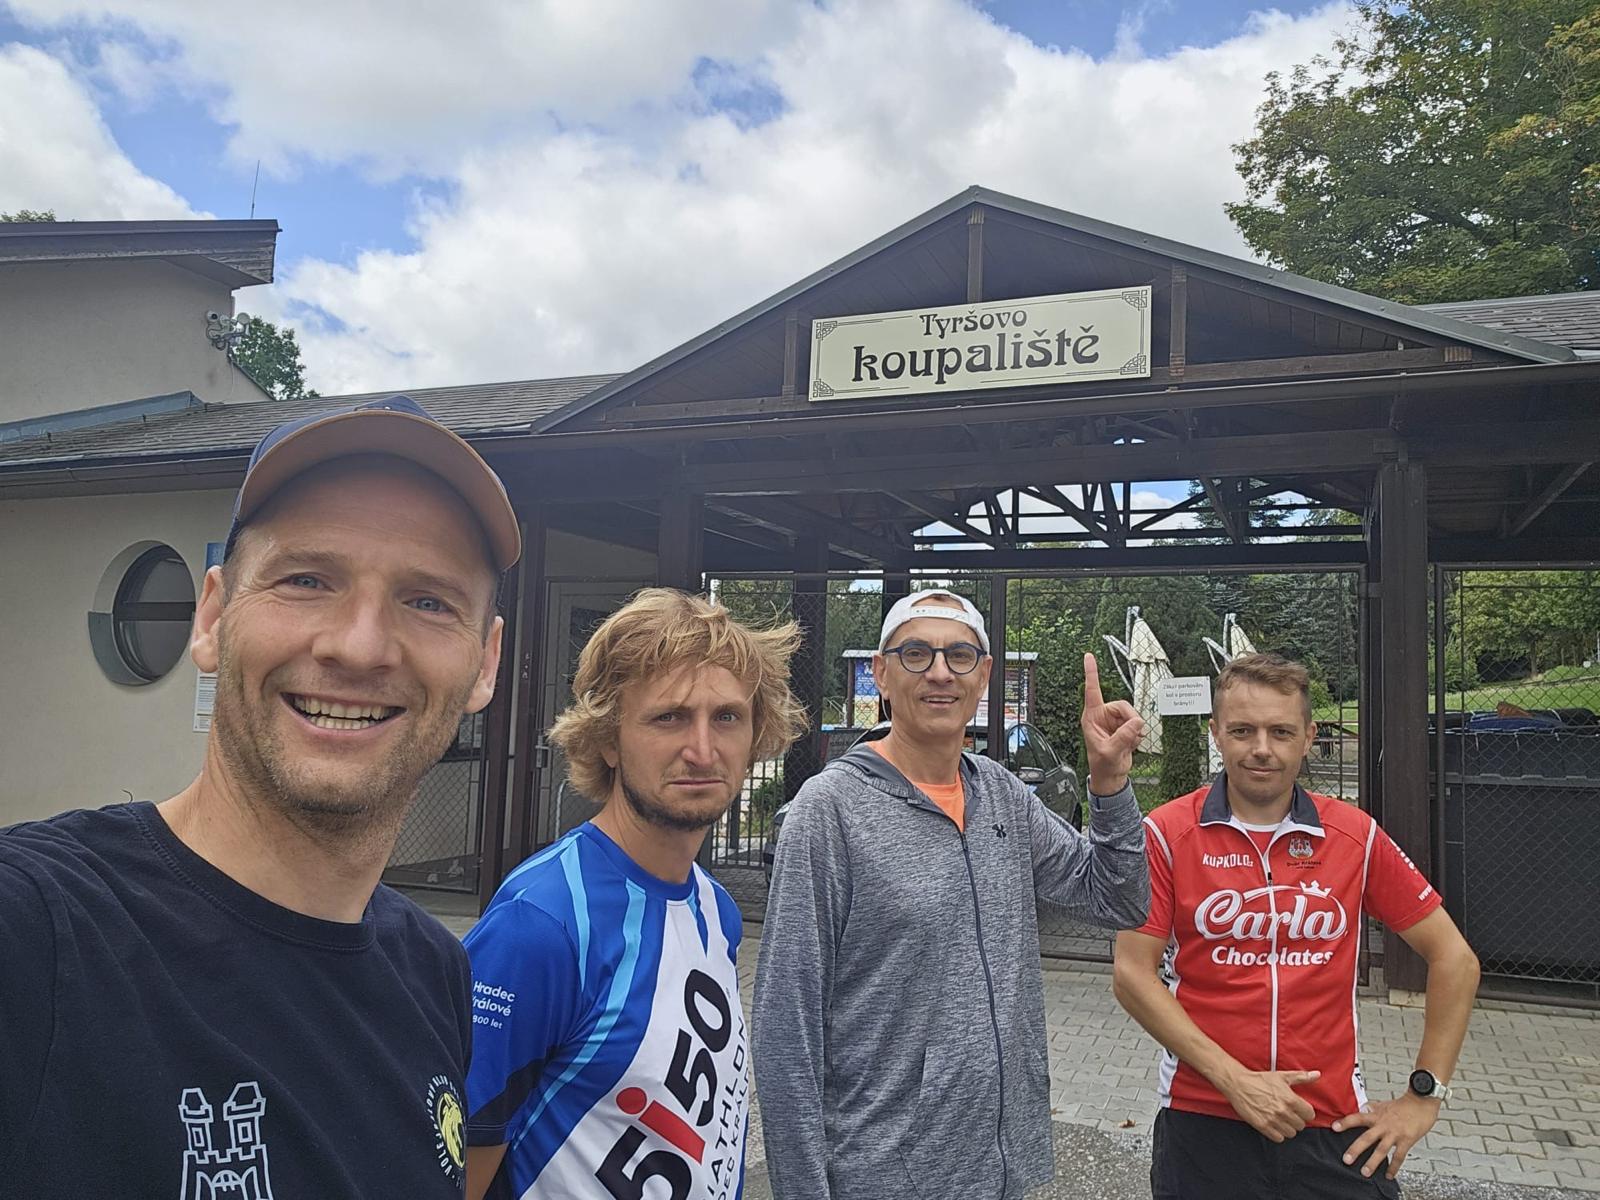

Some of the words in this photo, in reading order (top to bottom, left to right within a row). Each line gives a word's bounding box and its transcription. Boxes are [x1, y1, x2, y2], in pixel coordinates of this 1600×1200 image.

[919, 309, 1028, 339] Tyršovo
[852, 325, 1100, 385] koupaliště
[1194, 886, 1347, 941] Carla
[1211, 945, 1334, 967] Chocolates
[472, 981, 516, 1003] Hradec
[472, 995, 512, 1017] rálové
[490, 1018, 503, 1029] let
[595, 968, 733, 1200] 5i50
[704, 1016, 746, 1200] IATHLON
